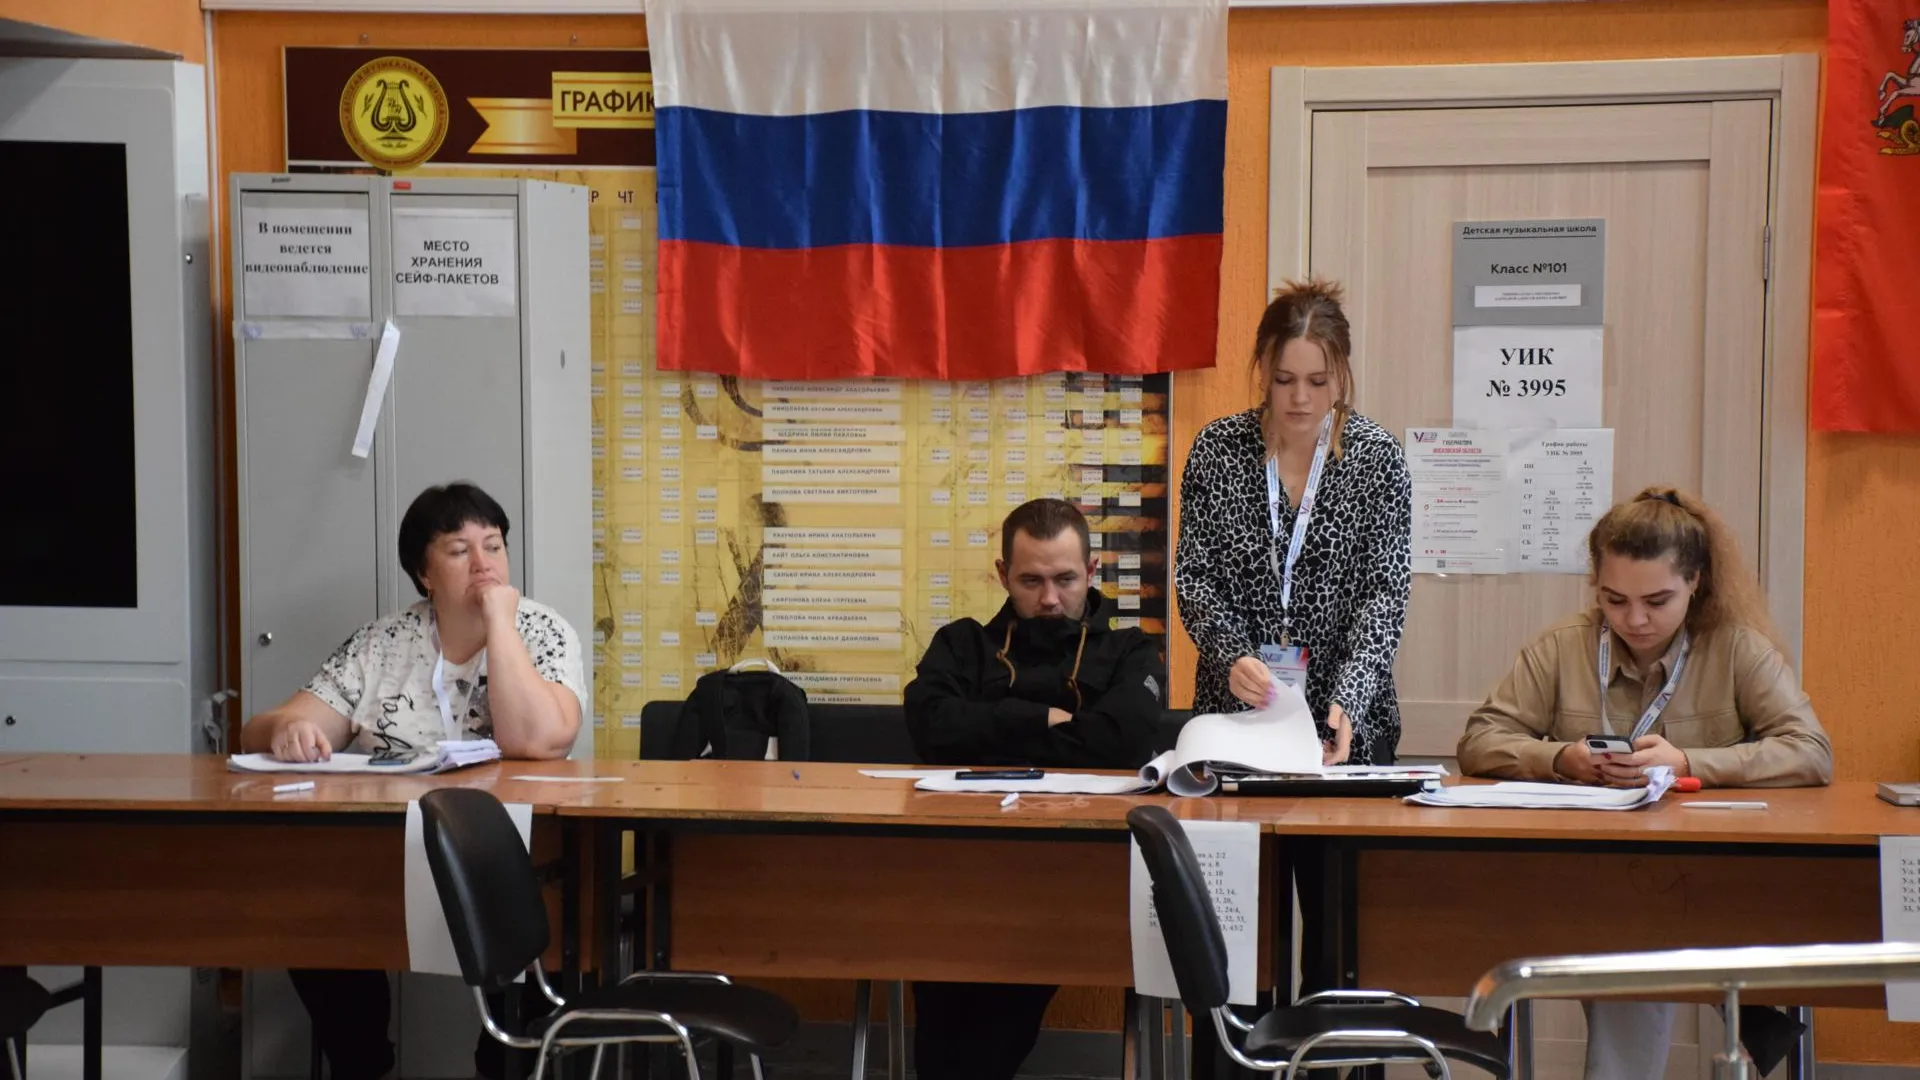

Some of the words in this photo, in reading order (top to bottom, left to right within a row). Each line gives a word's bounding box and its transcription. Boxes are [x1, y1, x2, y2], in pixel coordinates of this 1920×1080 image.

[561, 89, 656, 113] ГРАФИК
[617, 190, 635, 203] ЧТ
[258, 221, 268, 234] В
[272, 223, 352, 236] помещении
[1462, 226, 1500, 235] Детская
[1502, 226, 1565, 235] музыкальная
[1567, 225, 1597, 233] школа
[279, 243, 332, 255] ведется
[423, 240, 470, 252] МЕСТО
[245, 261, 369, 274] видеонаблюдение
[411, 256, 483, 269] ХРАНЕНИЯ
[1490, 263, 1529, 274] Класс
[395, 271, 500, 285] СЕЙФ-ПАКЕТОВ
[1500, 347, 1554, 366] УИК
[1486, 379, 1510, 397] №
[1517, 379, 1566, 397] 3995
